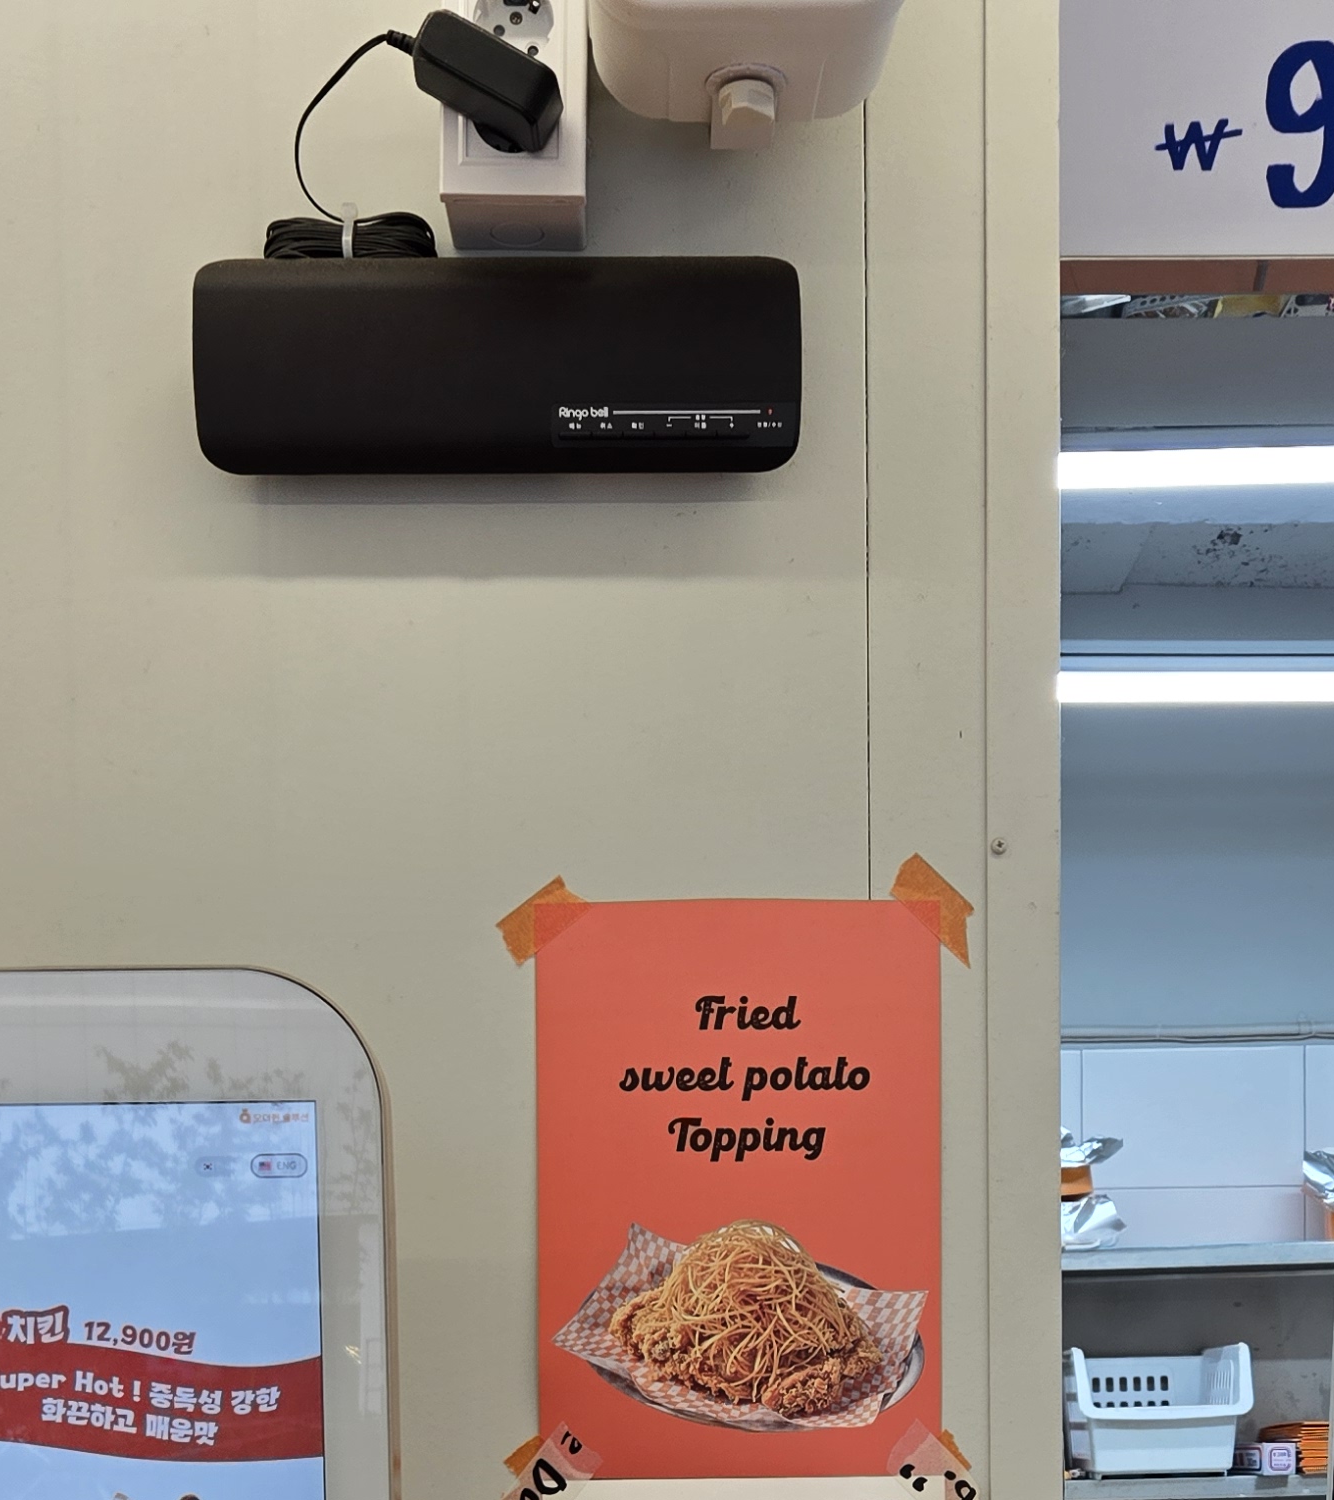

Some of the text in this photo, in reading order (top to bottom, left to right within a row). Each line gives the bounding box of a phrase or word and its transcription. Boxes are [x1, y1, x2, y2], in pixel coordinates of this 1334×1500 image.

[695, 995, 801, 1031] Fried
[619, 1056, 870, 1101] sweet potato
[668, 1117, 826, 1162] Topping
[277, 1161, 297, 1170] ENG
[7, 1311, 65, 1345] 치킨
[84, 1321, 196, 1355] 12,900원
[75, 1372, 124, 1397] Hot
[149, 1384, 222, 1414] 중독성
[231, 1387, 280, 1414] 강한
[41, 1398, 218, 1446] 화끈하고 매운맛
